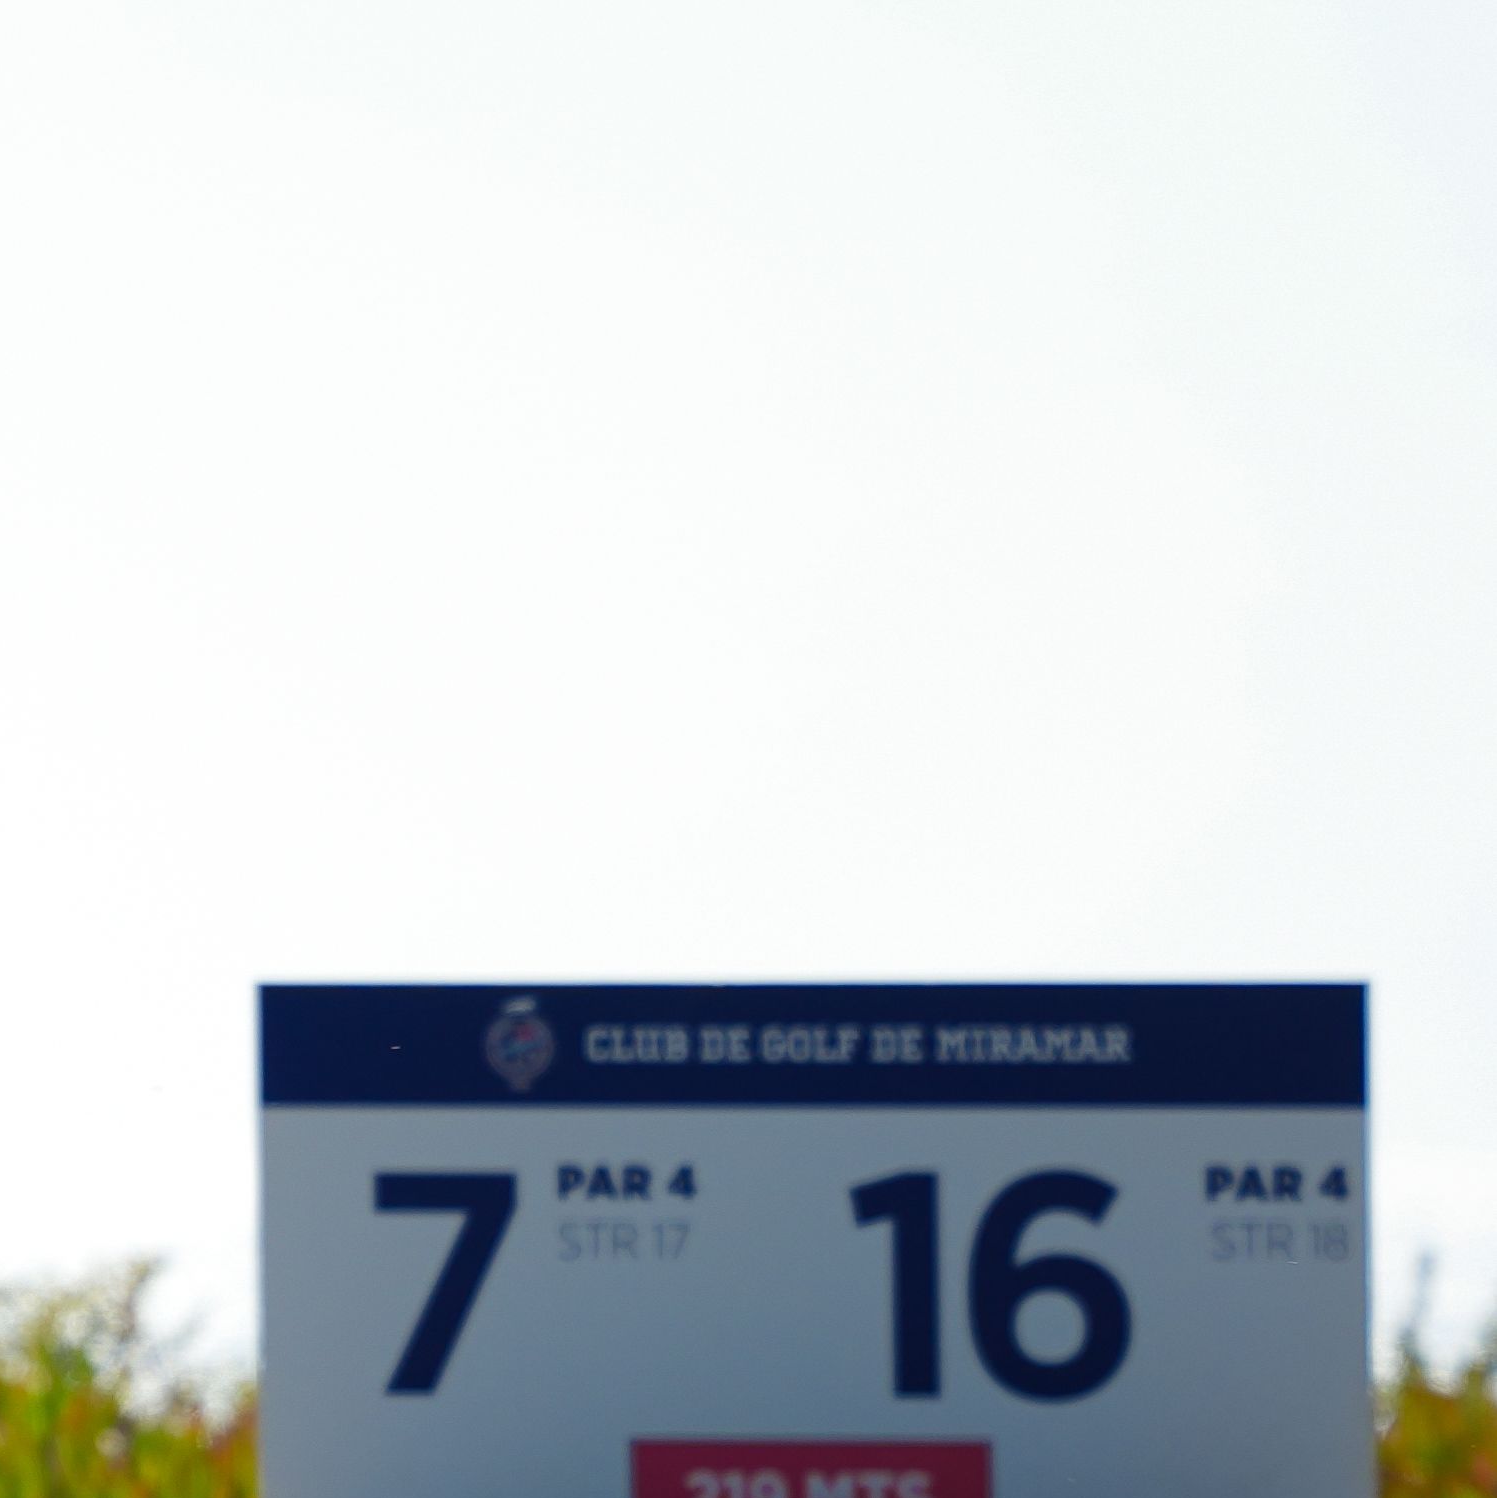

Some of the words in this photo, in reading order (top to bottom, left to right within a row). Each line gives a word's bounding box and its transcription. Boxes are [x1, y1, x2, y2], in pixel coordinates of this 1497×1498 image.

[586, 1026, 689, 1063] CLUB
[699, 1026, 752, 1063] DE
[760, 1026, 861, 1063] GOLF
[871, 1026, 924, 1063] DE
[936, 1026, 1131, 1063] MIRAMAR
[557, 1164, 652, 1199] PAR
[667, 1164, 697, 1198] 4
[1206, 1166, 1303, 1201] PAR
[1318, 1166, 1349, 1200] 4
[557, 1222, 639, 1261] STR
[653, 1222, 691, 1259] 17
[1210, 1222, 1295, 1262] STR
[1312, 1223, 1350, 1261] 18
[373, 1172, 517, 1396] 7
[851, 1169, 1132, 1401] 16
